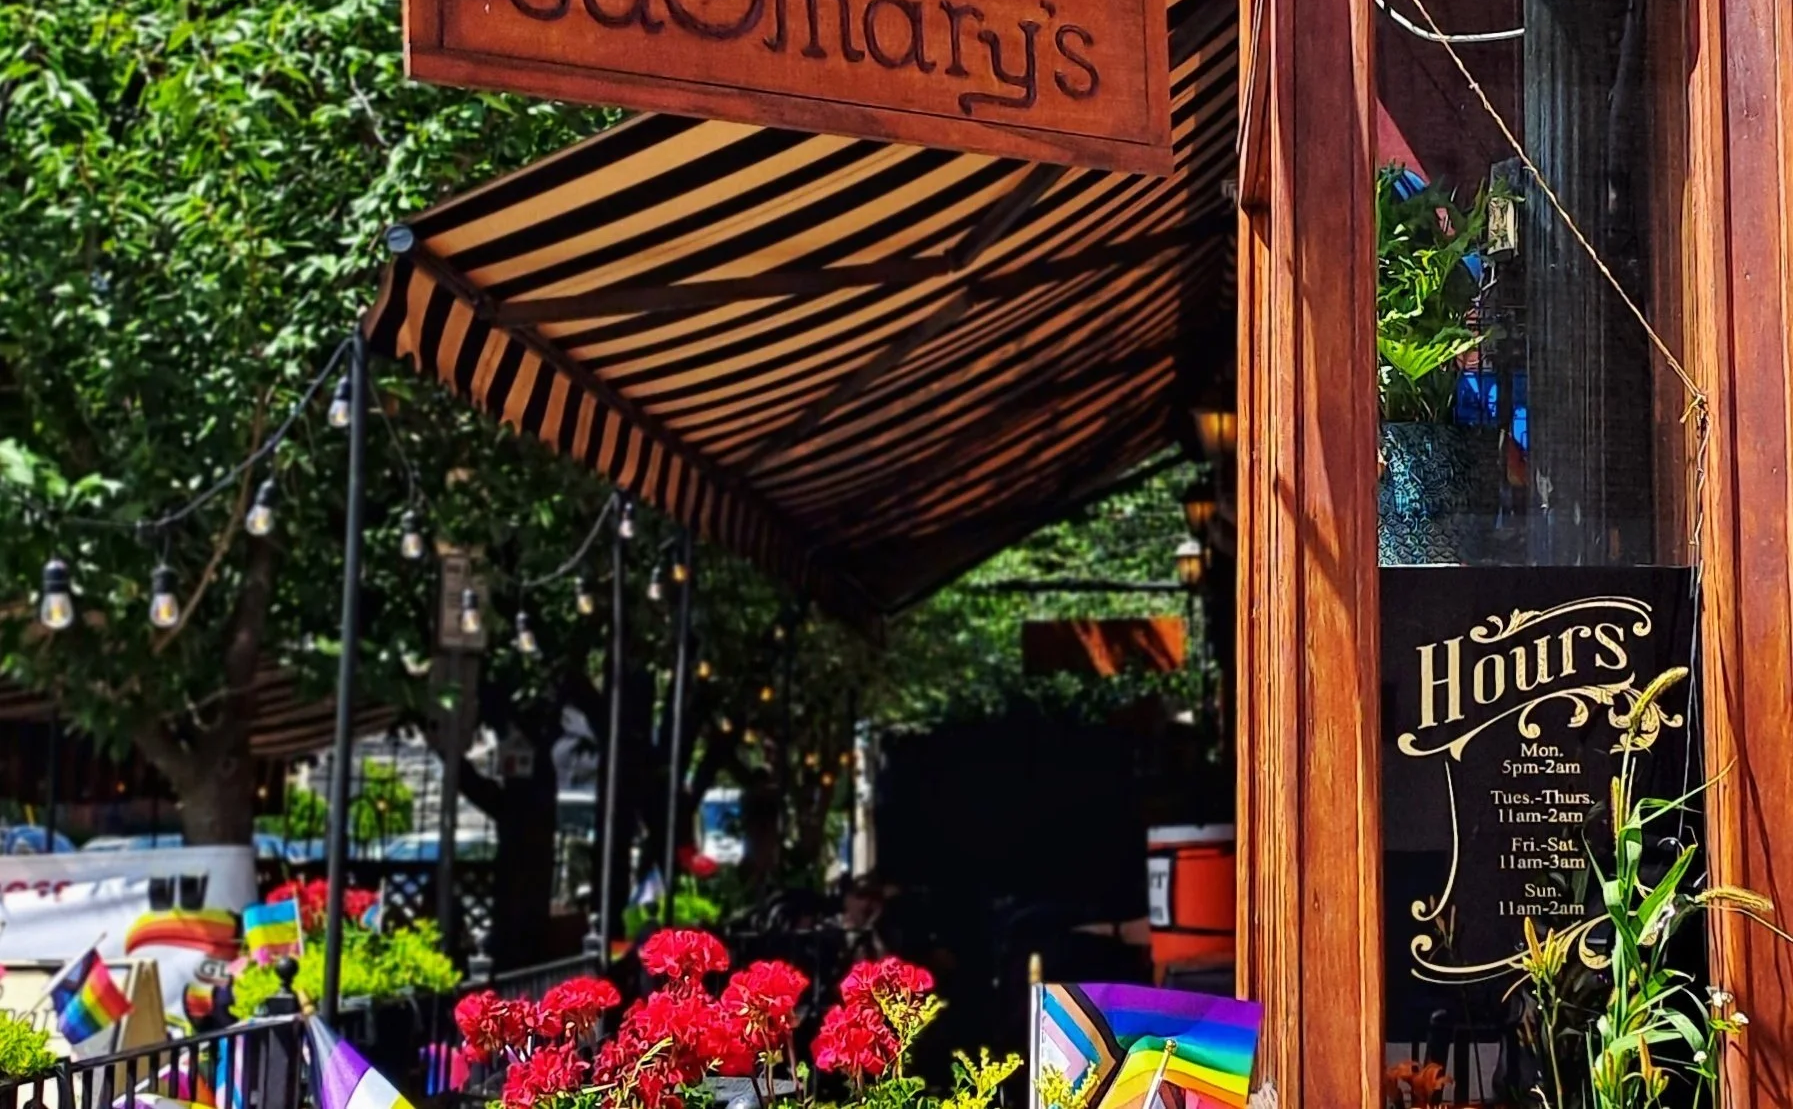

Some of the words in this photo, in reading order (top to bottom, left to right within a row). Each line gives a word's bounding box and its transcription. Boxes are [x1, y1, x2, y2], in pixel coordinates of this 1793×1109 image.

[1416, 622, 1628, 730] Hours
[1520, 742, 1564, 757] Mon.
[1502, 760, 1581, 777] 5pm-2am
[1490, 790, 1595, 804] Tues.-Thurs.
[1498, 808, 1583, 823] 11am-2am
[1500, 854, 1585, 869] 11am-3am
[1524, 883, 1562, 897] Sun.
[1499, 901, 1585, 915] 11am-2am
